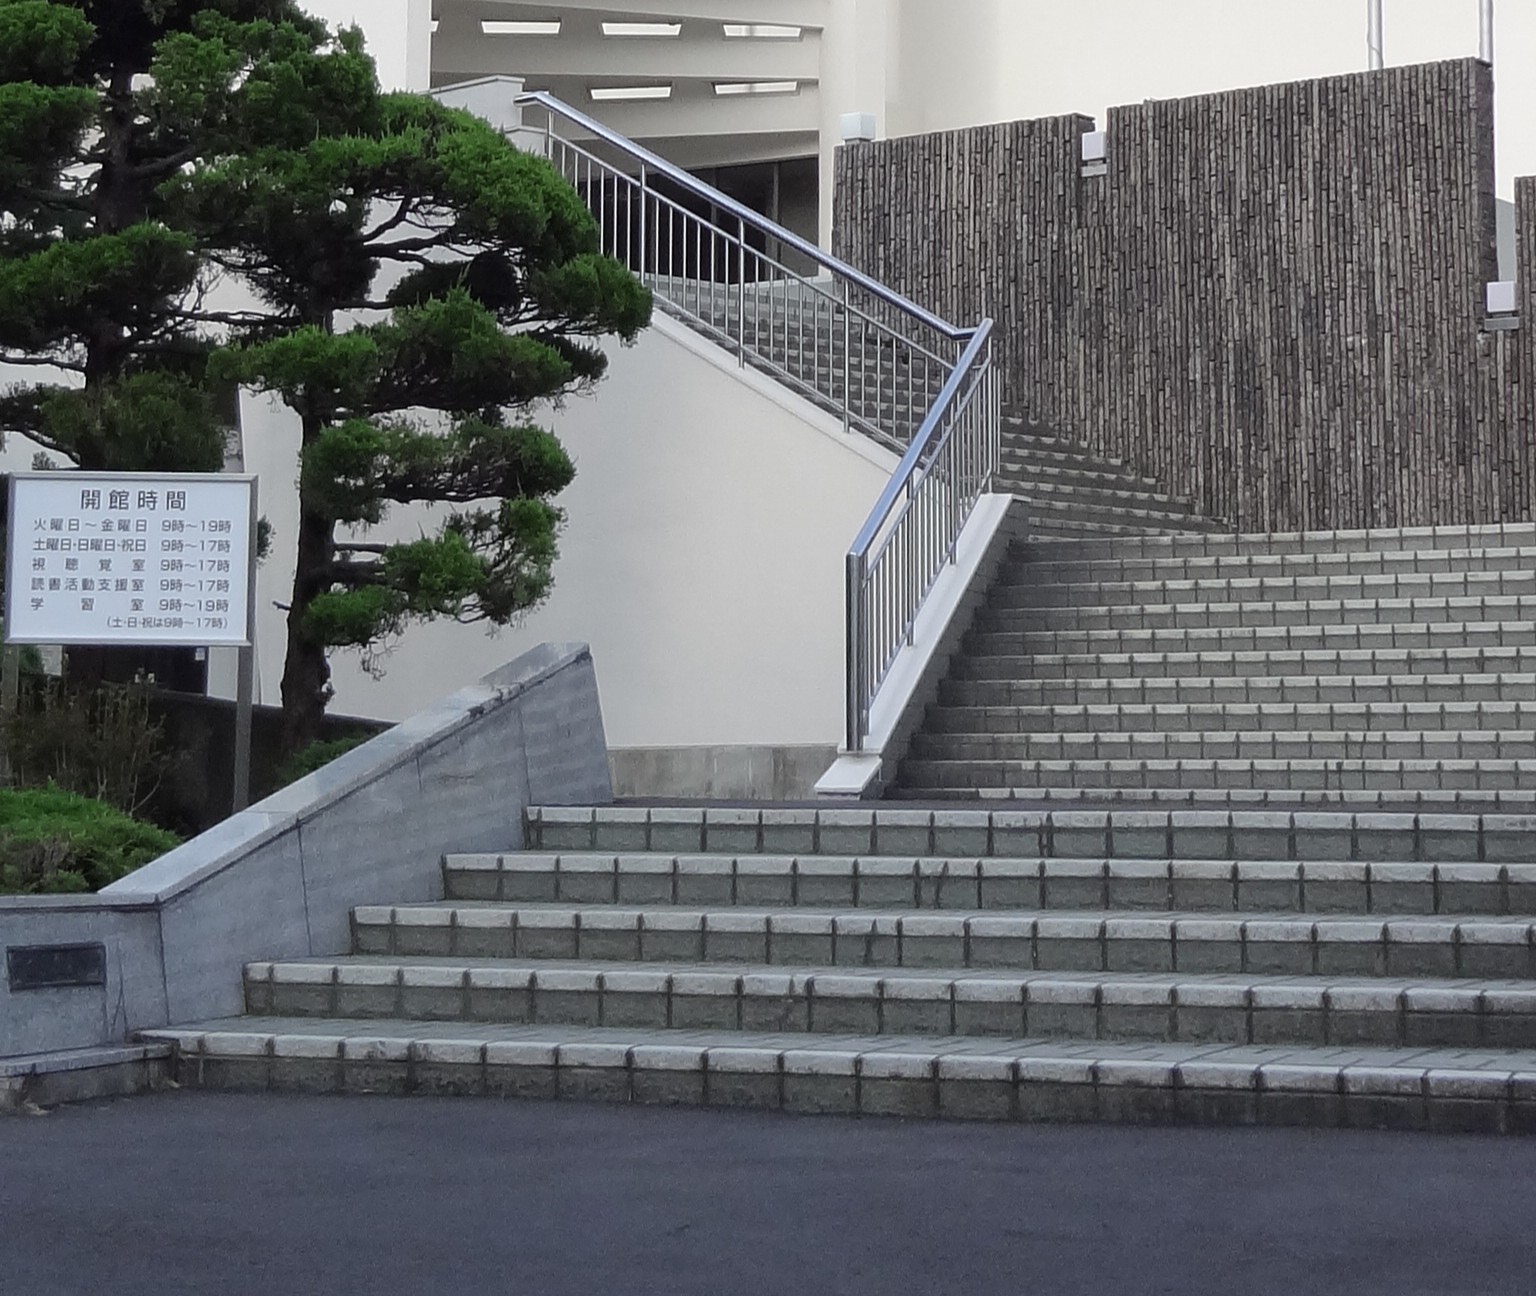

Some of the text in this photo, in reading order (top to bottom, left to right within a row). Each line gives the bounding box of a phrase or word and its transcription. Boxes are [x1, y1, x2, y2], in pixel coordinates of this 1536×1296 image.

[80, 489, 187, 511] 開館時間
[32, 557, 146, 572] 視聴覚室
[31, 577, 145, 592] 読書活動支援室
[30, 597, 145, 612] 学習室
